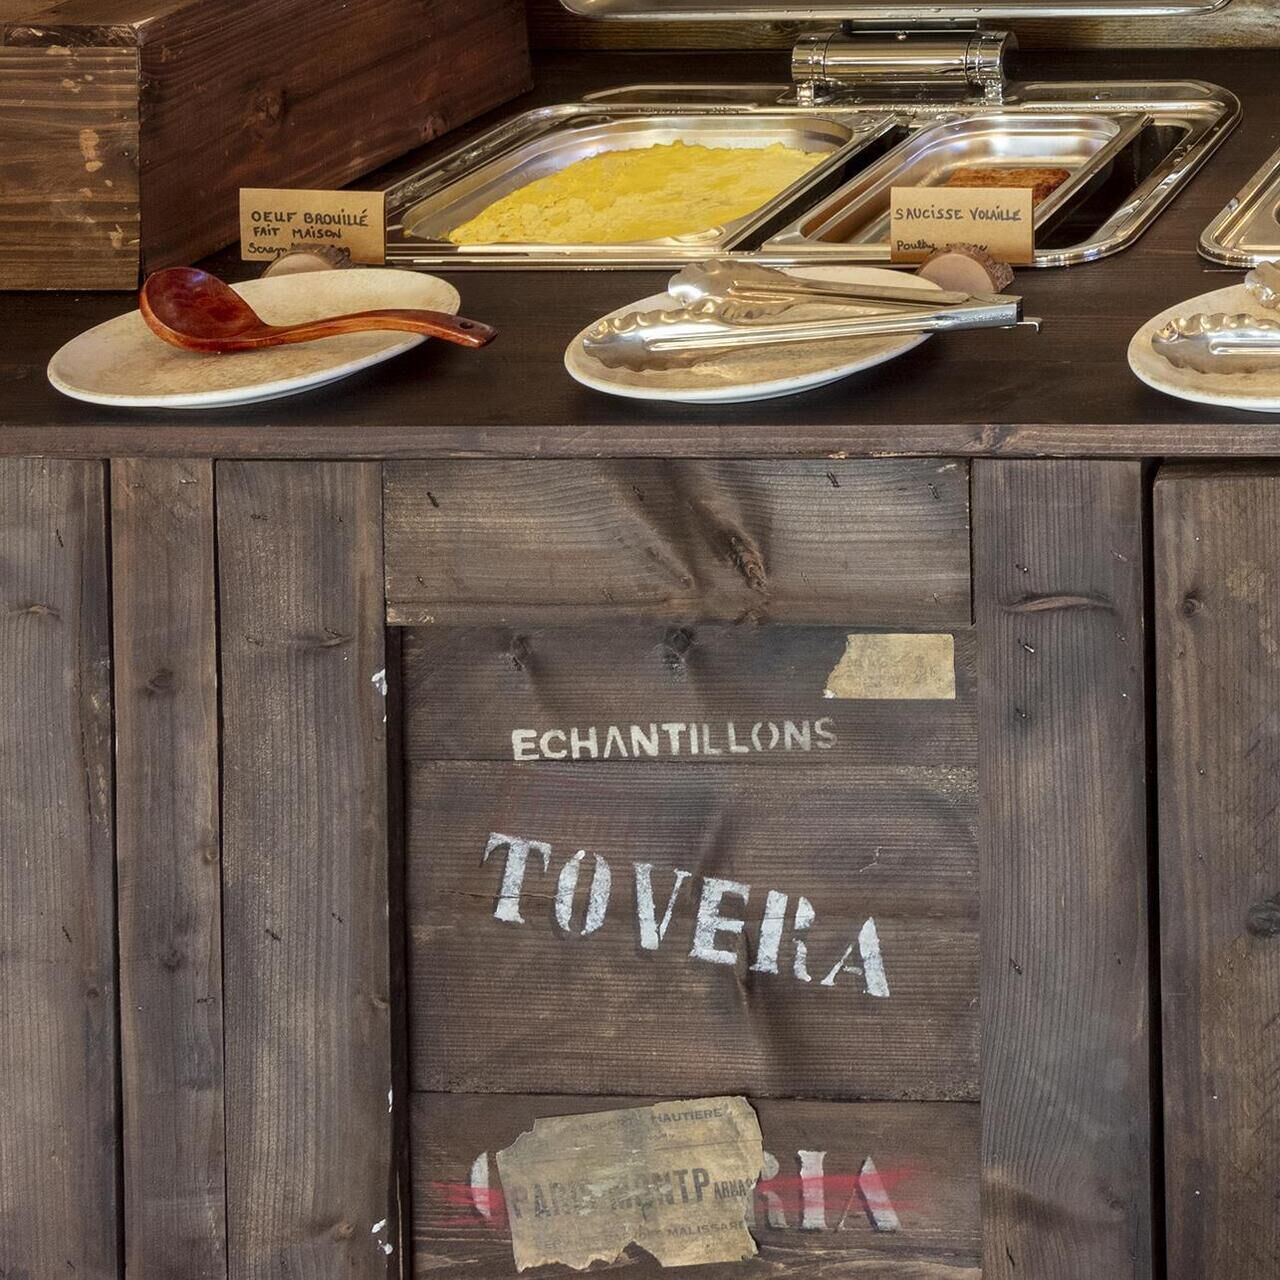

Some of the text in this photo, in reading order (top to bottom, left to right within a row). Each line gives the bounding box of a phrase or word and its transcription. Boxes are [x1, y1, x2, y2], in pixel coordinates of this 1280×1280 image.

[251, 208, 369, 227] OEUF BROUILLÉ
[894, 204, 1022, 221] SAUCISSE VOLAILLE
[253, 224, 342, 239] FAIT MAISON
[511, 717, 838, 762] ECHANTILLONS
[482, 831, 890, 998] TOVERA
